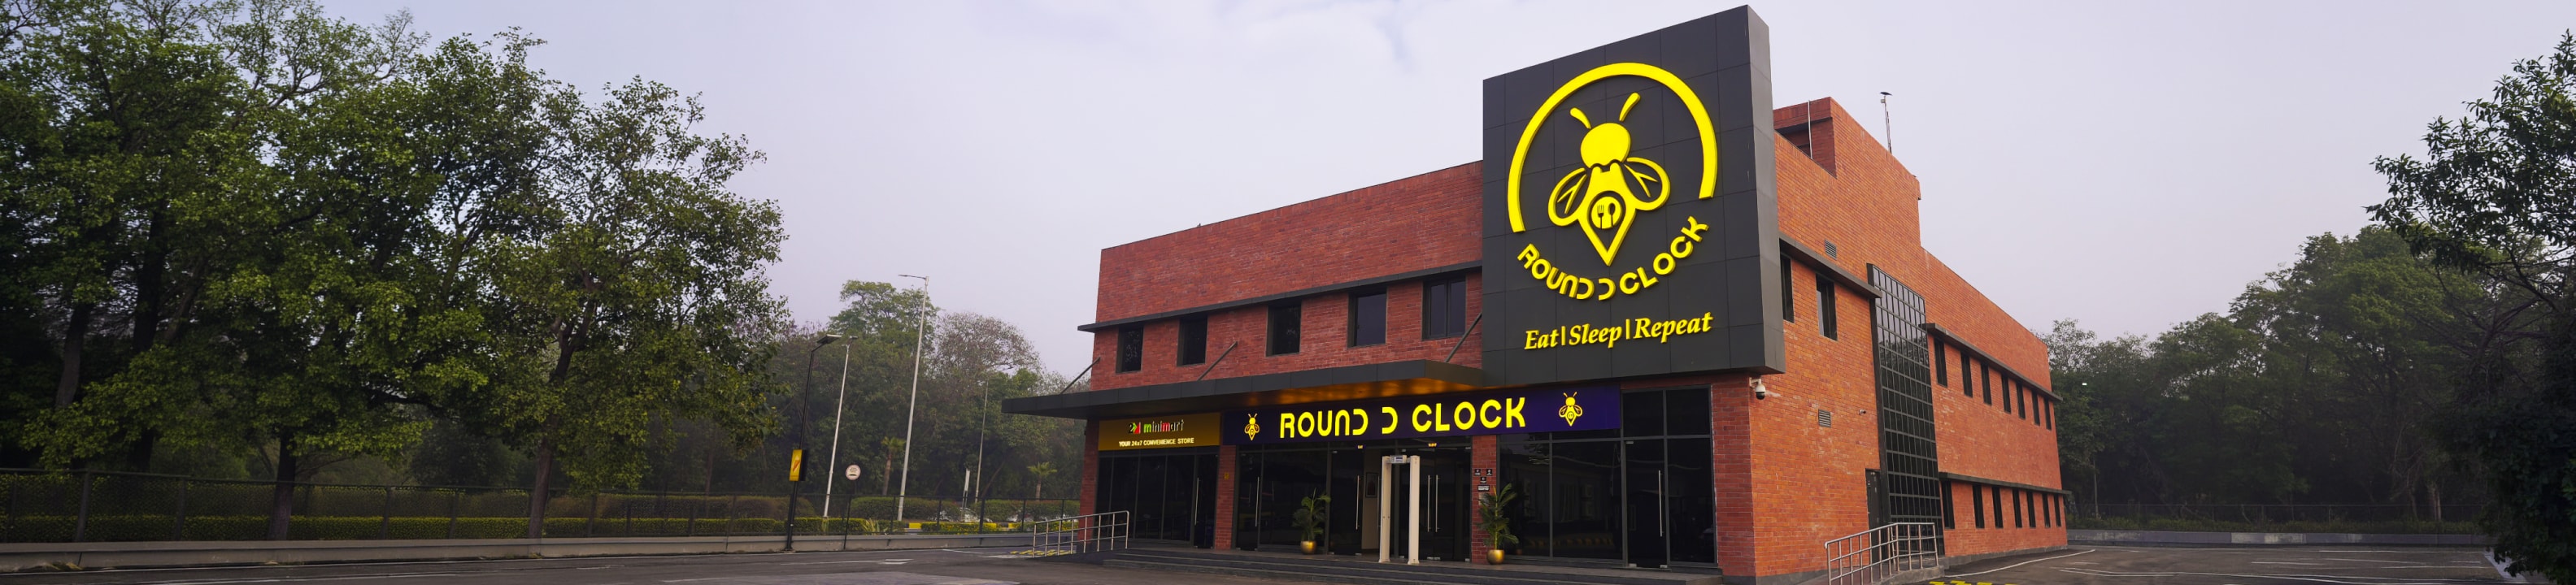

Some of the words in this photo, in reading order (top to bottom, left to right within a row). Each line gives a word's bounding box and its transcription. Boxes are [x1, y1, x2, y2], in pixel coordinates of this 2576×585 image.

[1516, 243, 1595, 301] ROUND
[1619, 215, 1709, 295] CLOCK
[1279, 408, 1368, 439] ROUND
[1412, 396, 1526, 432] CLOCK
